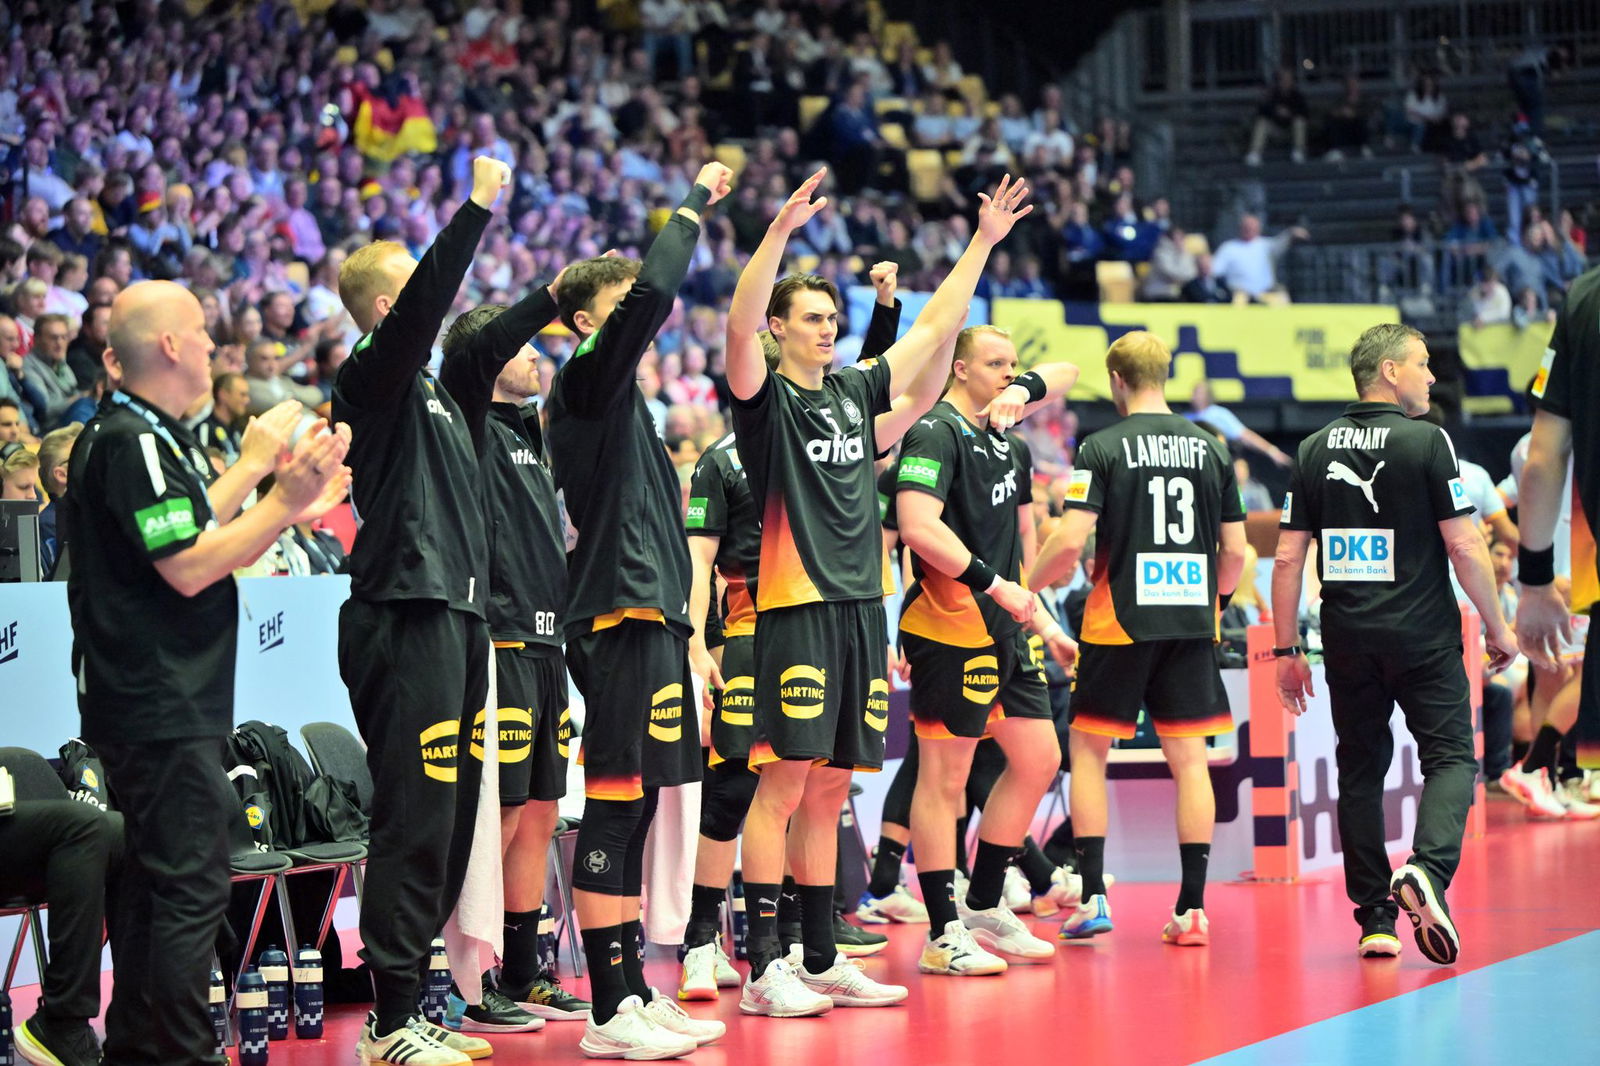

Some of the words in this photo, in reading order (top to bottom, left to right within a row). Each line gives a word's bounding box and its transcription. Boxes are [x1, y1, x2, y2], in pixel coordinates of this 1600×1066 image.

[806, 434, 864, 462] atla
[1327, 427, 1391, 449] GERMANY
[1122, 434, 1207, 470] LANGHOFF
[899, 463, 937, 478] ALSCO
[687, 506, 705, 516] SCO
[1148, 476, 1195, 545] 13
[1328, 535, 1389, 561] DKB
[1143, 561, 1202, 585] DKB
[1328, 565, 1343, 574] Das
[1344, 564, 1364, 574] kann
[1366, 565, 1388, 574] Bank
[259, 610, 284, 645] EHF
[535, 611, 555, 635] 80
[0, 620, 18, 655] HF
[781, 686, 825, 700] HARTING
[421, 744, 458, 760] HART
